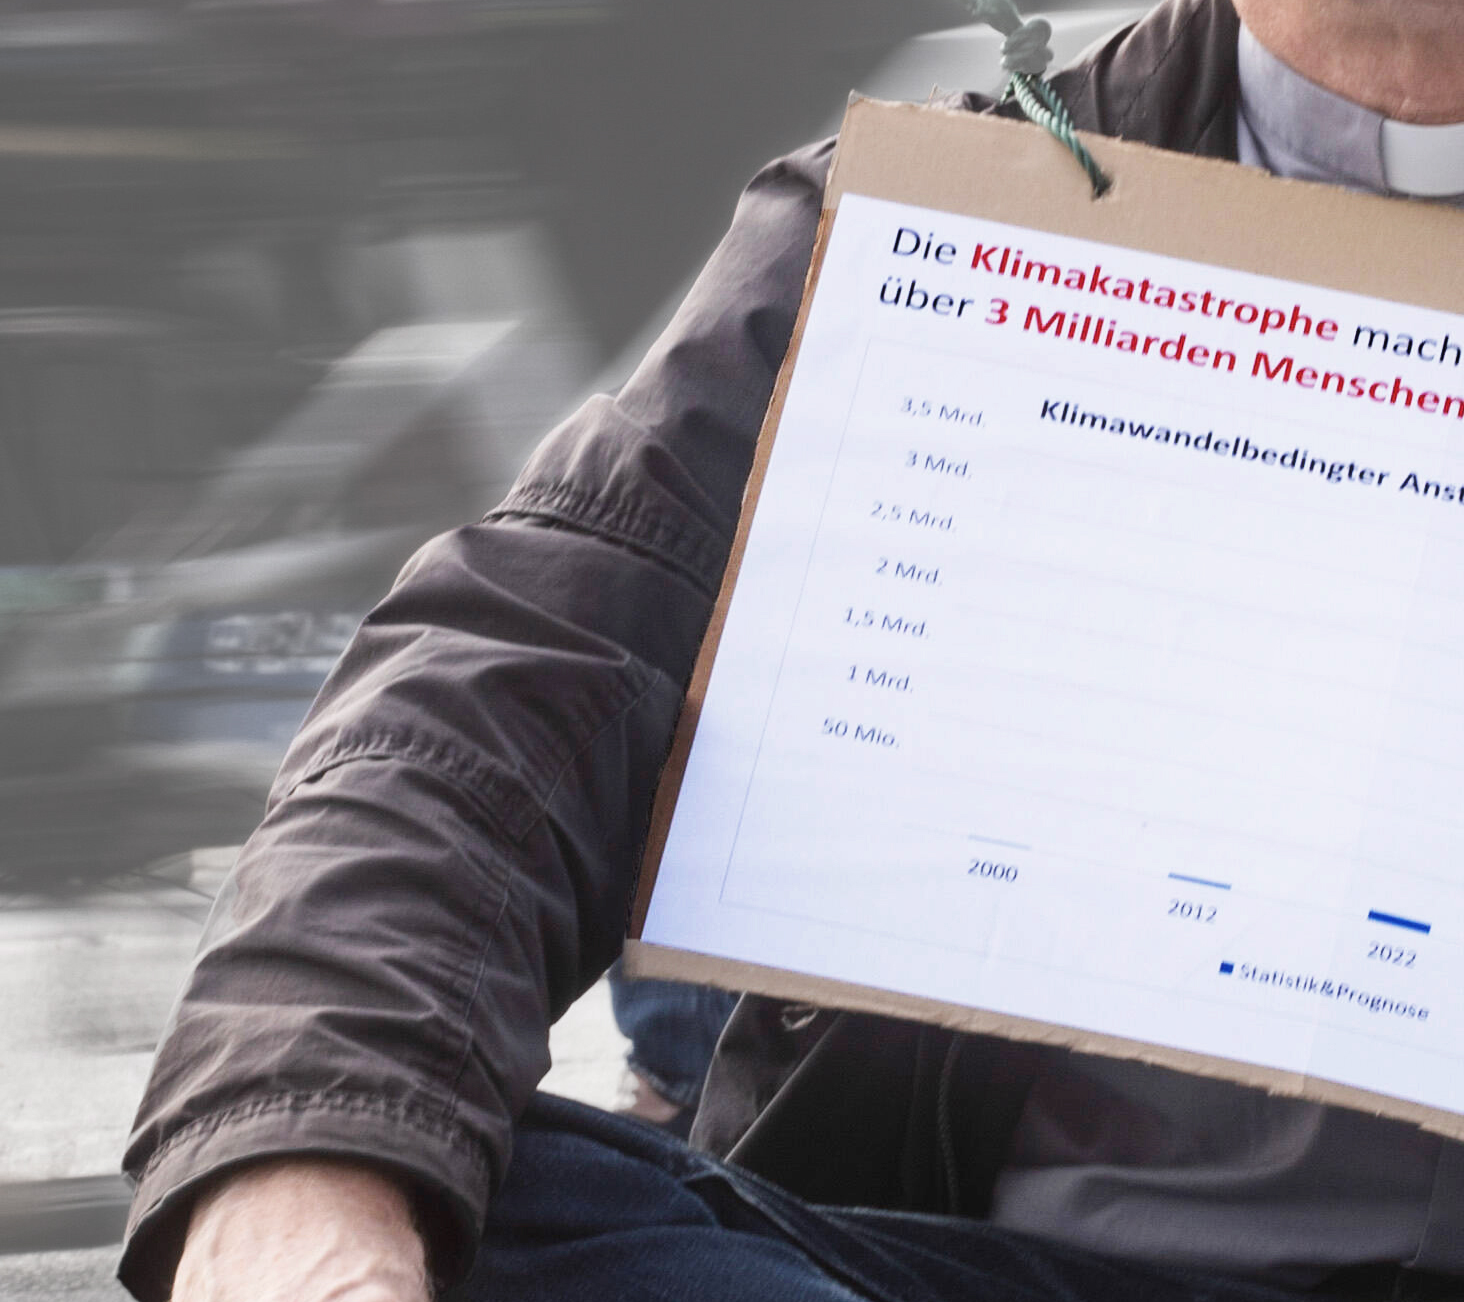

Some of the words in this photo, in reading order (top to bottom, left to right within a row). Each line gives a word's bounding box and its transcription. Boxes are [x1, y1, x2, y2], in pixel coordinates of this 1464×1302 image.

[892, 226, 957, 265] Die
[971, 242, 1339, 341] Klimakatastrophe
[879, 275, 974, 319] über
[984, 296, 1010, 327] 3
[1023, 305, 1238, 373] Milliarden
[901, 396, 932, 417] 3,5
[938, 404, 986, 428] Mrd.
[1039, 398, 1390, 487] Klimawandelbedingter
[905, 449, 919, 468] 3
[924, 453, 973, 479] Mrd.
[870, 500, 901, 521] 2,5
[908, 508, 956, 533] Mrd.
[875, 556, 889, 576] 2
[894, 561, 943, 587] Mrd.
[843, 606, 874, 628] 1,5
[881, 613, 930, 640] Mrd.
[847, 664, 858, 682] 1
[865, 667, 914, 693] Mrd.
[821, 716, 848, 738] 50
[854, 723, 900, 749] Mio.
[966, 857, 1019, 884] 2000
[1166, 896, 1218, 925] 2012
[1366, 941, 1418, 969] 2022
[1239, 961, 1430, 1023] Statistik&Prognose
